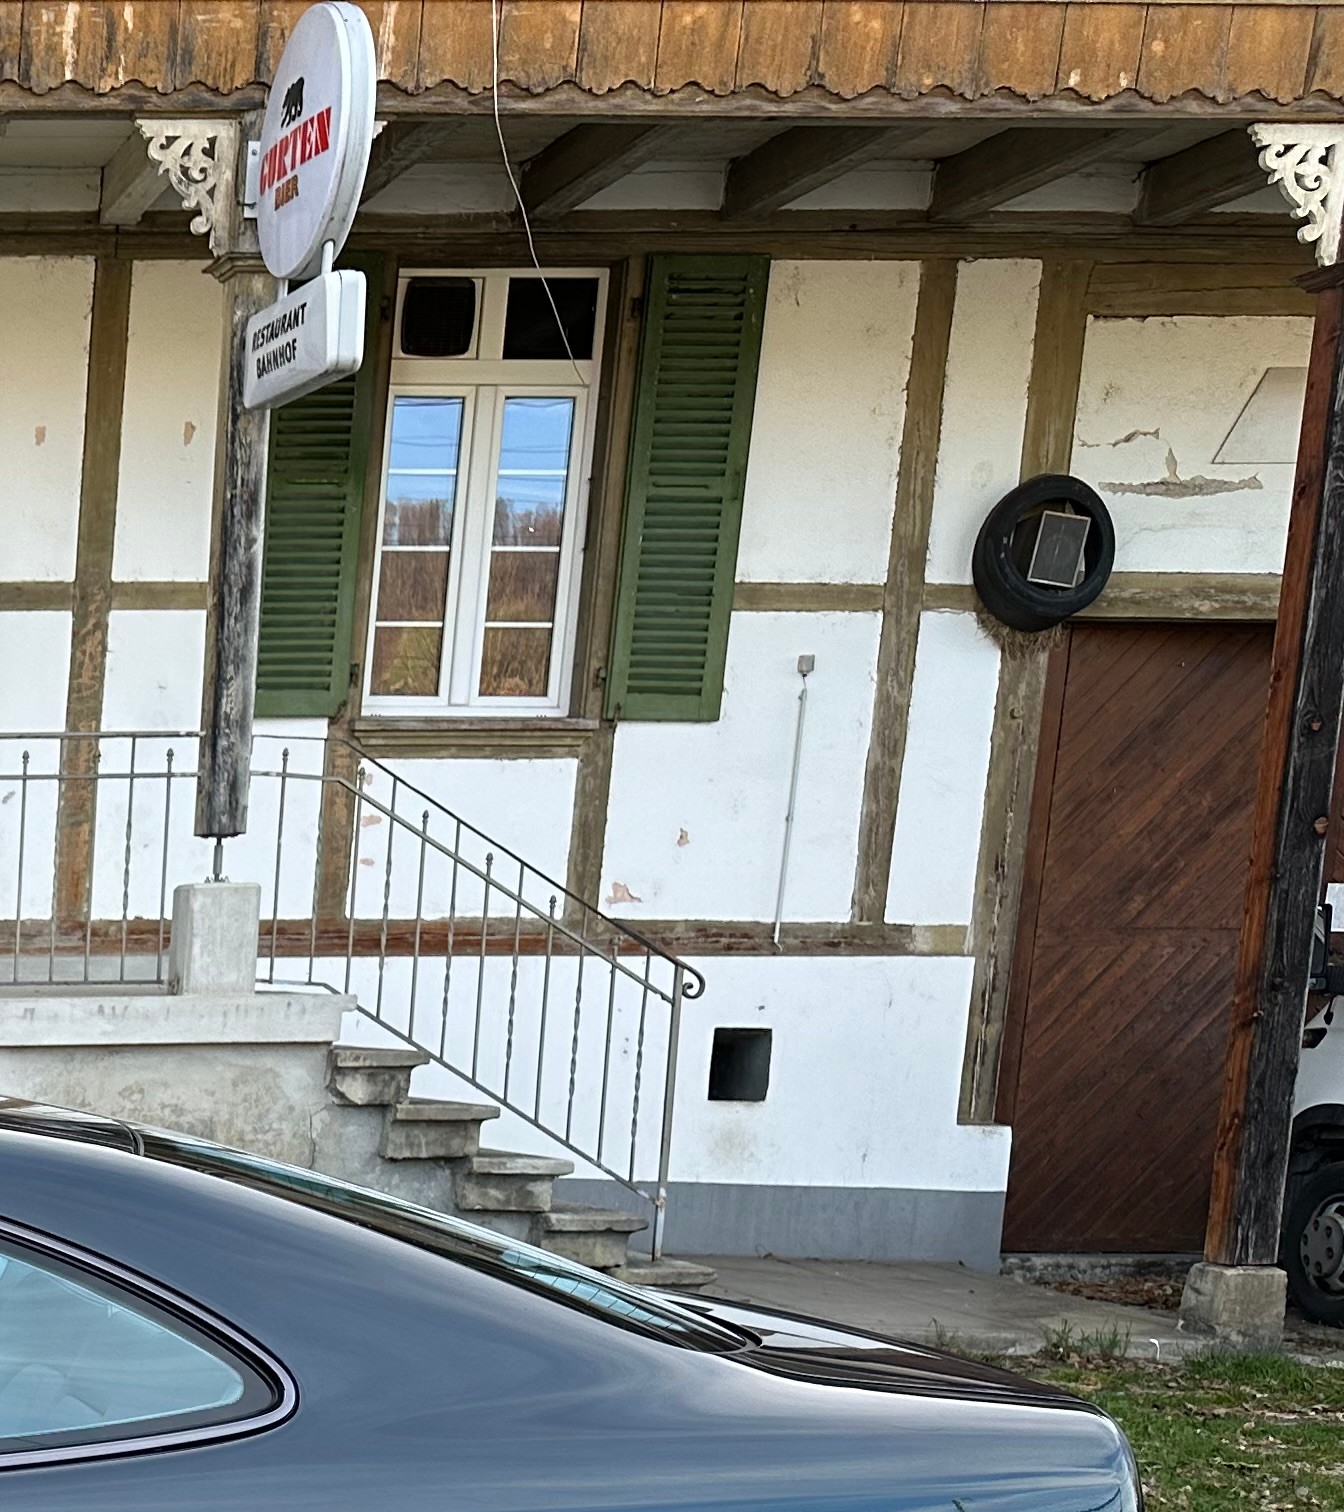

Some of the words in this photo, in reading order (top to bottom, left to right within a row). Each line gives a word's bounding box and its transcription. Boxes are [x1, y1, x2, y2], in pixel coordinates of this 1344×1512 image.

[259, 105, 332, 197] GURTEN
[274, 174, 299, 212] BIER
[252, 301, 308, 353] RESTAURANT
[256, 337, 298, 380] BAHNHOF
